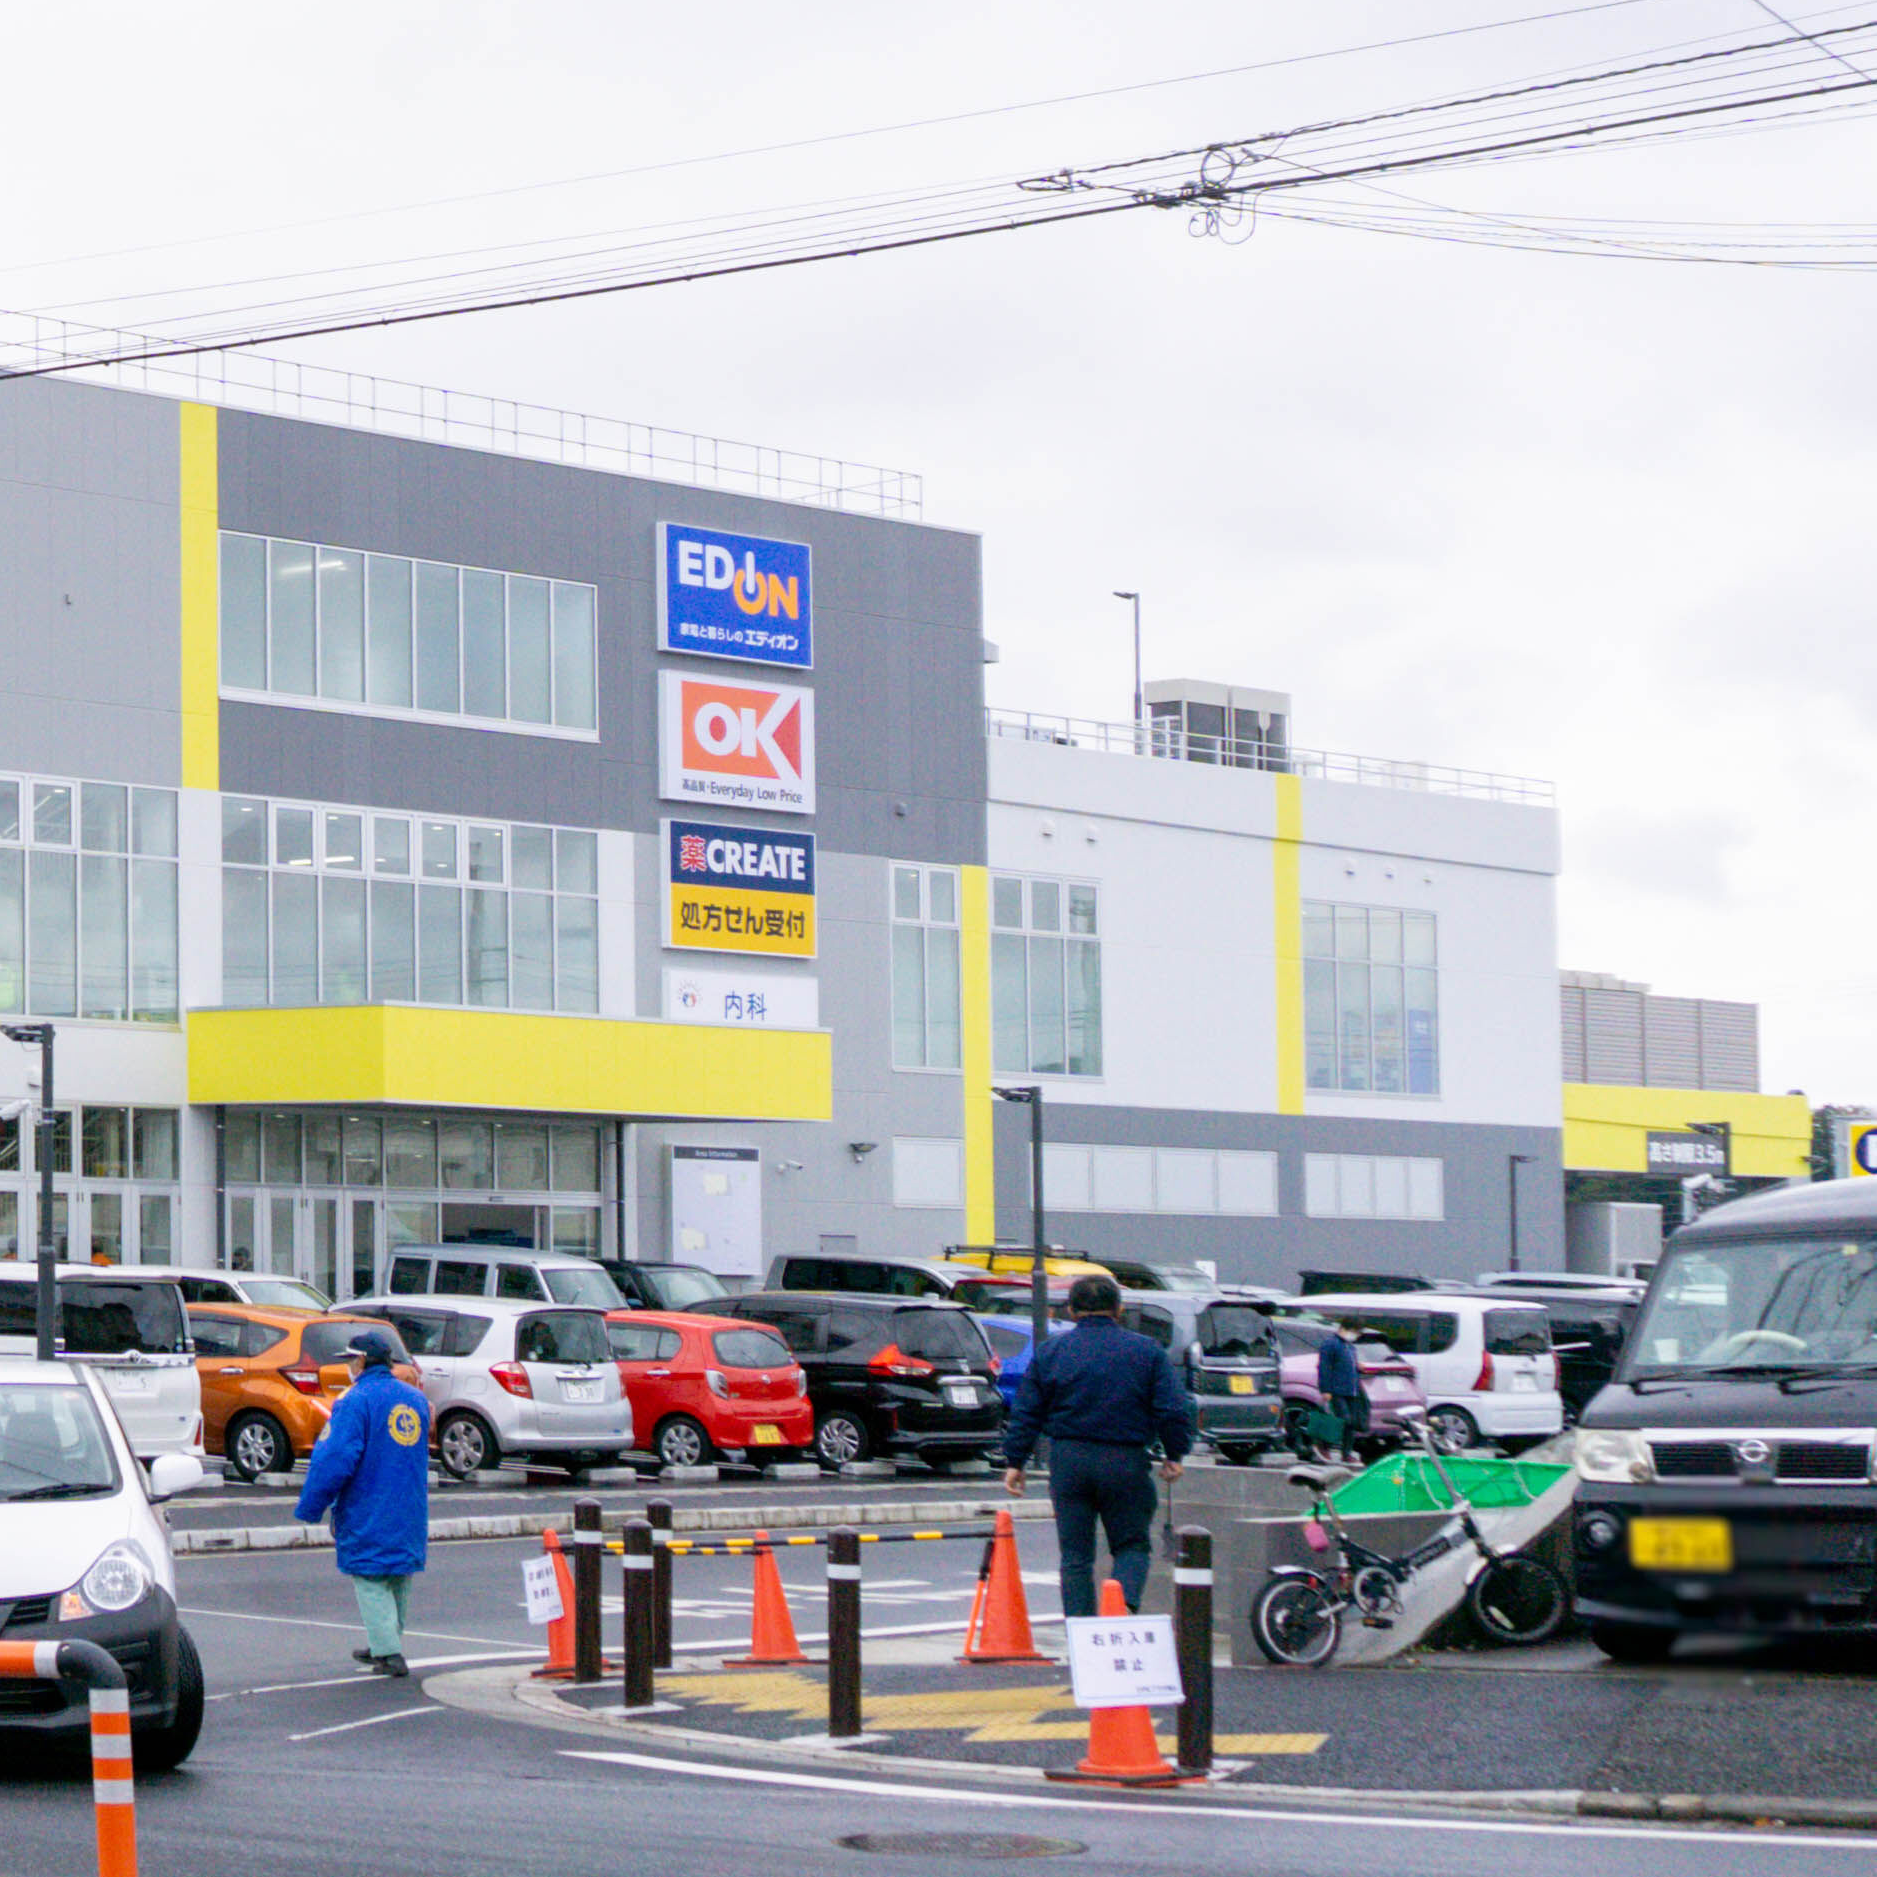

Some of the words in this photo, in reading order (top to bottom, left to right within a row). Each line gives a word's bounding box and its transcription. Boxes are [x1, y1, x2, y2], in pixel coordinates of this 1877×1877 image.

[678, 540, 799, 620] EDION
[694, 693, 802, 780] OK
[757, 787, 777, 801] Low
[780, 789, 803, 804] Price
[680, 901, 805, 939] 処方せん受付
[724, 990, 768, 1021] 内科
